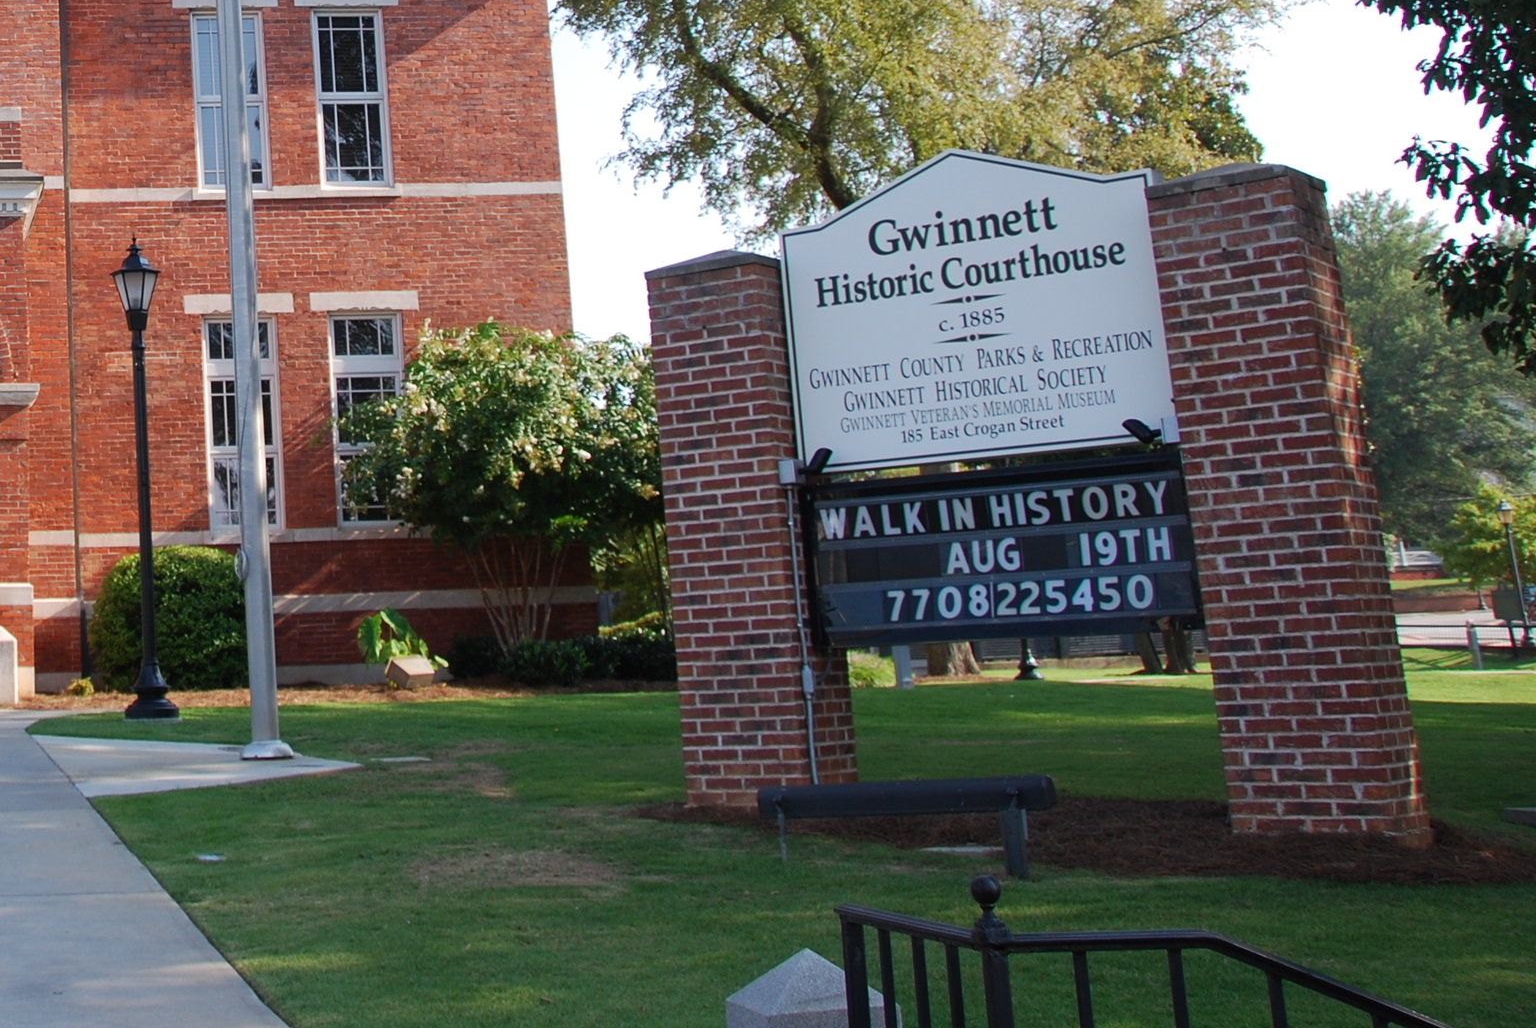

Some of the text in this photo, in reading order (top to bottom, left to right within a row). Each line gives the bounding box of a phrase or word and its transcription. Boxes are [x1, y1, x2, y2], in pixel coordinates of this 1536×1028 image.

[868, 196, 1059, 256] Gwinnett
[814, 239, 1127, 308] Historic Courthouse
[938, 306, 1005, 333] c. 1885
[809, 330, 1154, 390] GWINNETT COUNTY PARKS & RECREATION
[840, 389, 1117, 433] GWINNETT VETERAN'S MEMORIAL MUSEUM
[844, 365, 1108, 412] GWINNETT HISTORICAL SOCIETY
[901, 414, 1065, 444] 185 East Crogan Street
[819, 480, 1168, 540] WALK IN HISTORY
[946, 526, 1172, 575] AUG 19TH
[886, 574, 1154, 623] 7708225450
